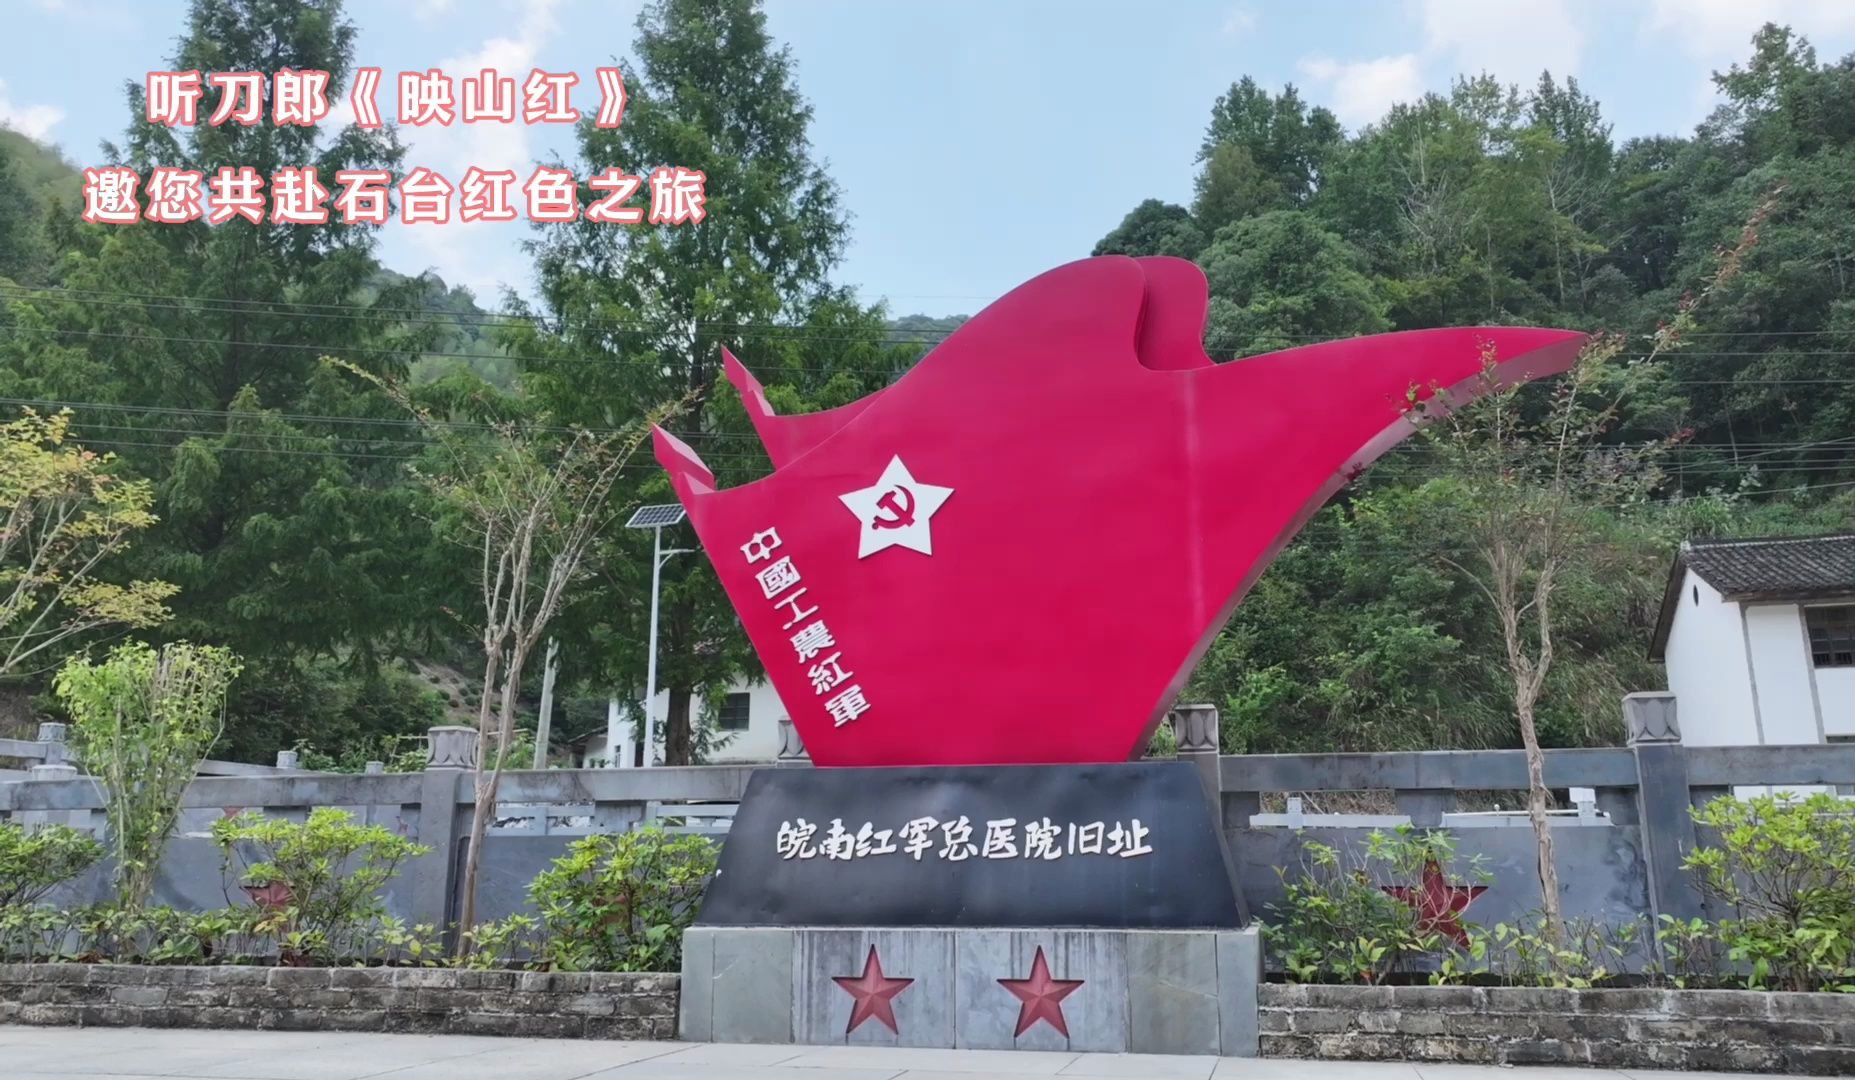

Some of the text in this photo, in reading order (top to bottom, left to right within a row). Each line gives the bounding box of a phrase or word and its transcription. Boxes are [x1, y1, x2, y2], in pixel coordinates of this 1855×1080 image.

[740, 526, 871, 728] 中國工農紅軍
[776, 815, 1154, 861] 皖南红军总医院旧址
